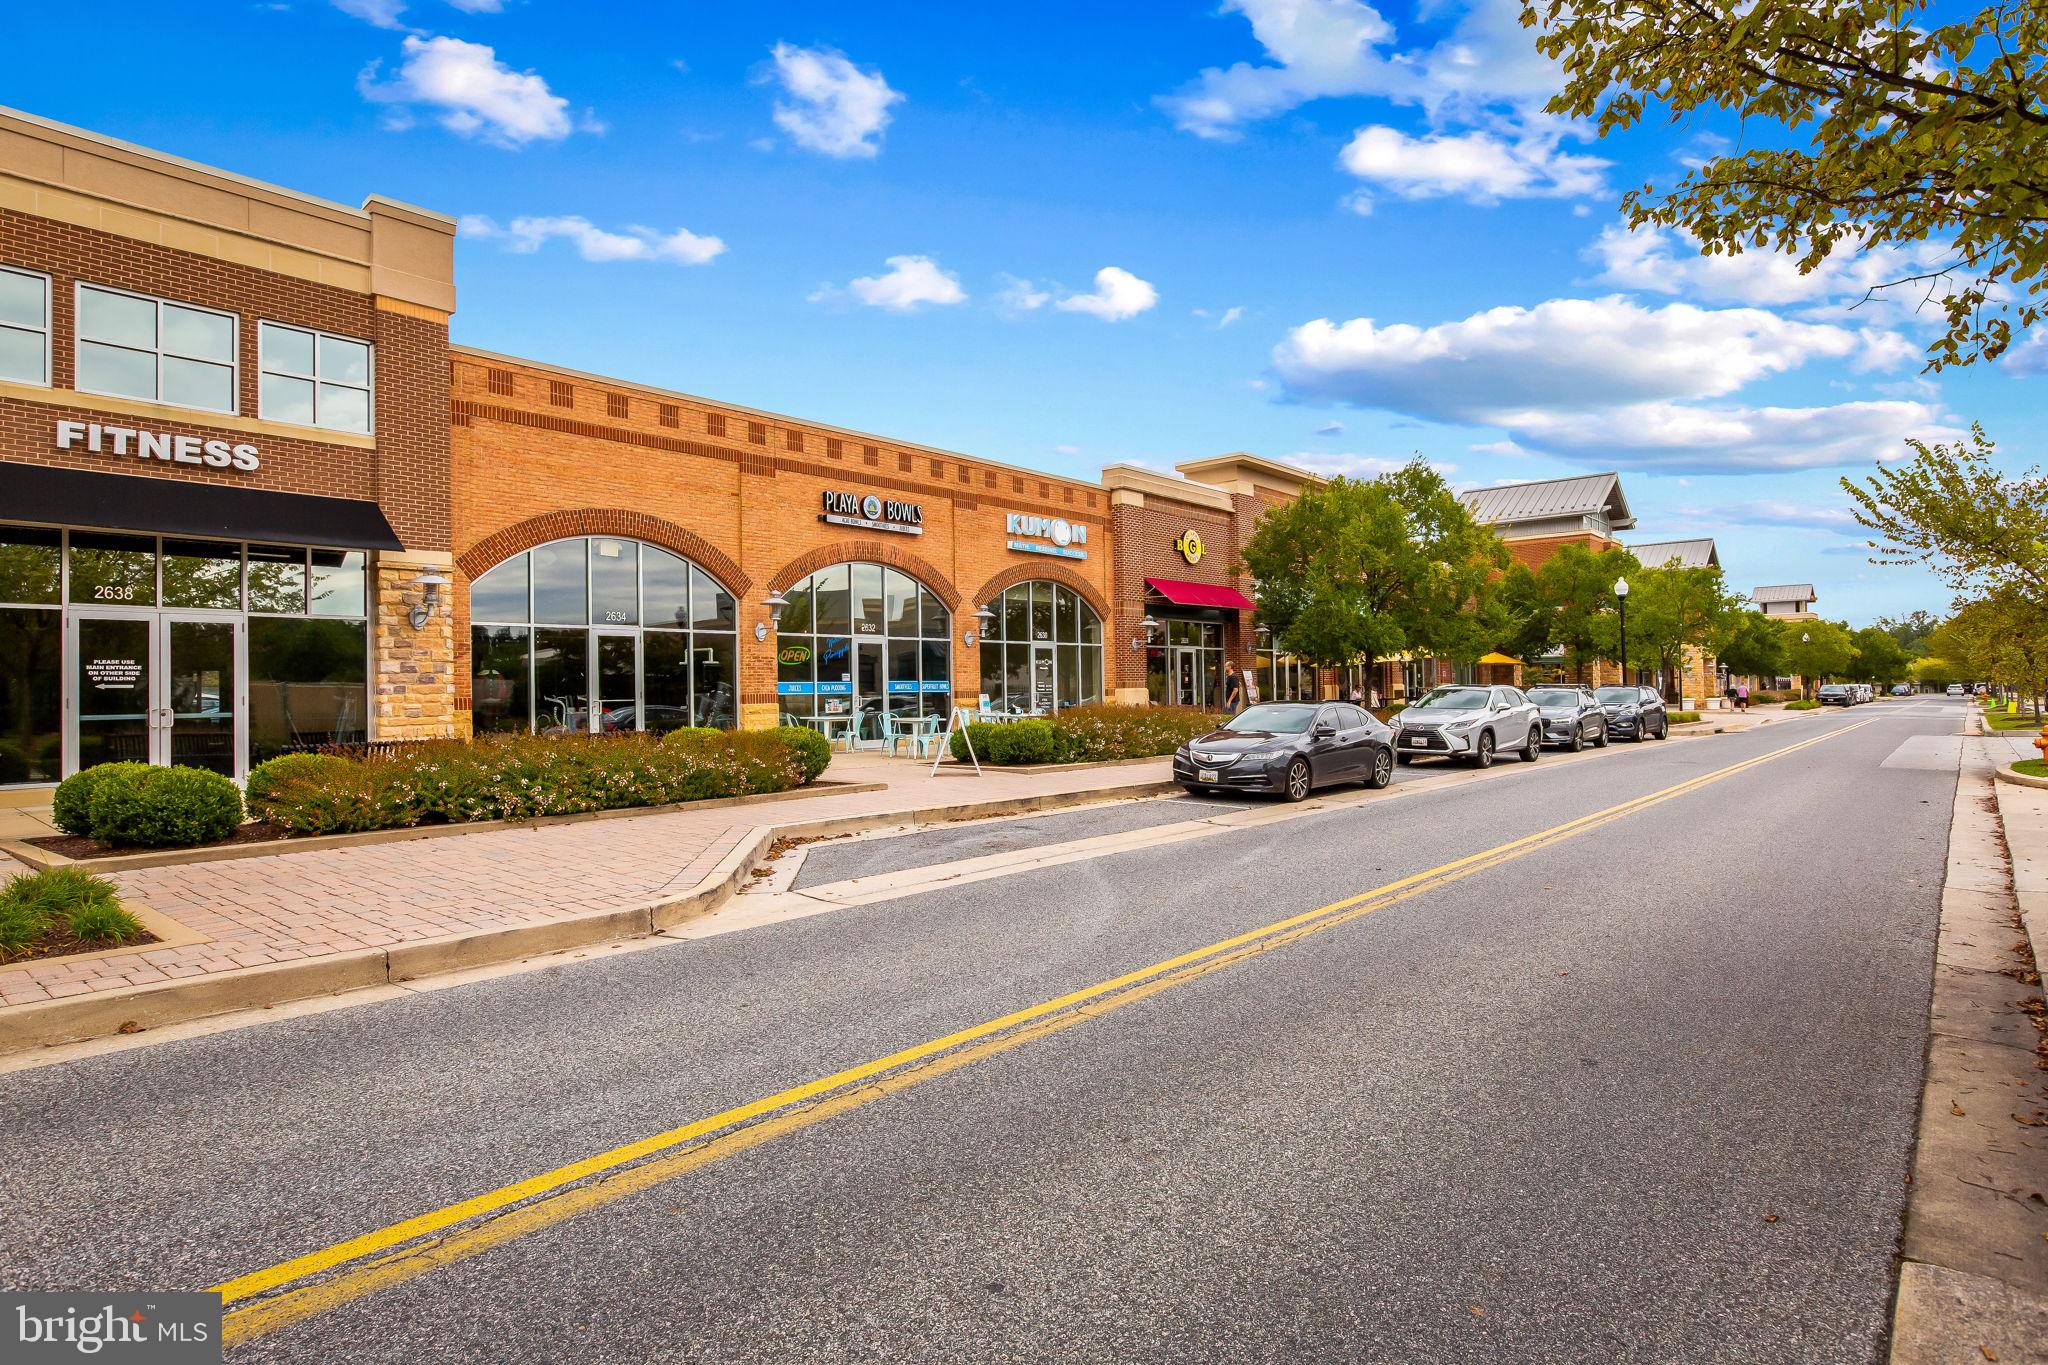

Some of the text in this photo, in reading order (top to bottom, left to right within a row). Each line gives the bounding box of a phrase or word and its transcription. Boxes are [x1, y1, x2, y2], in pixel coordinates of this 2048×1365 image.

[57, 420, 260, 471] FITNESS
[825, 491, 923, 523] PLAYA BOWLS
[1007, 513, 1087, 546] KUMON
[94, 585, 134, 600] 2638
[605, 611, 627, 621] 2634
[861, 623, 876, 632] 2632
[781, 649, 807, 662] OPEN
